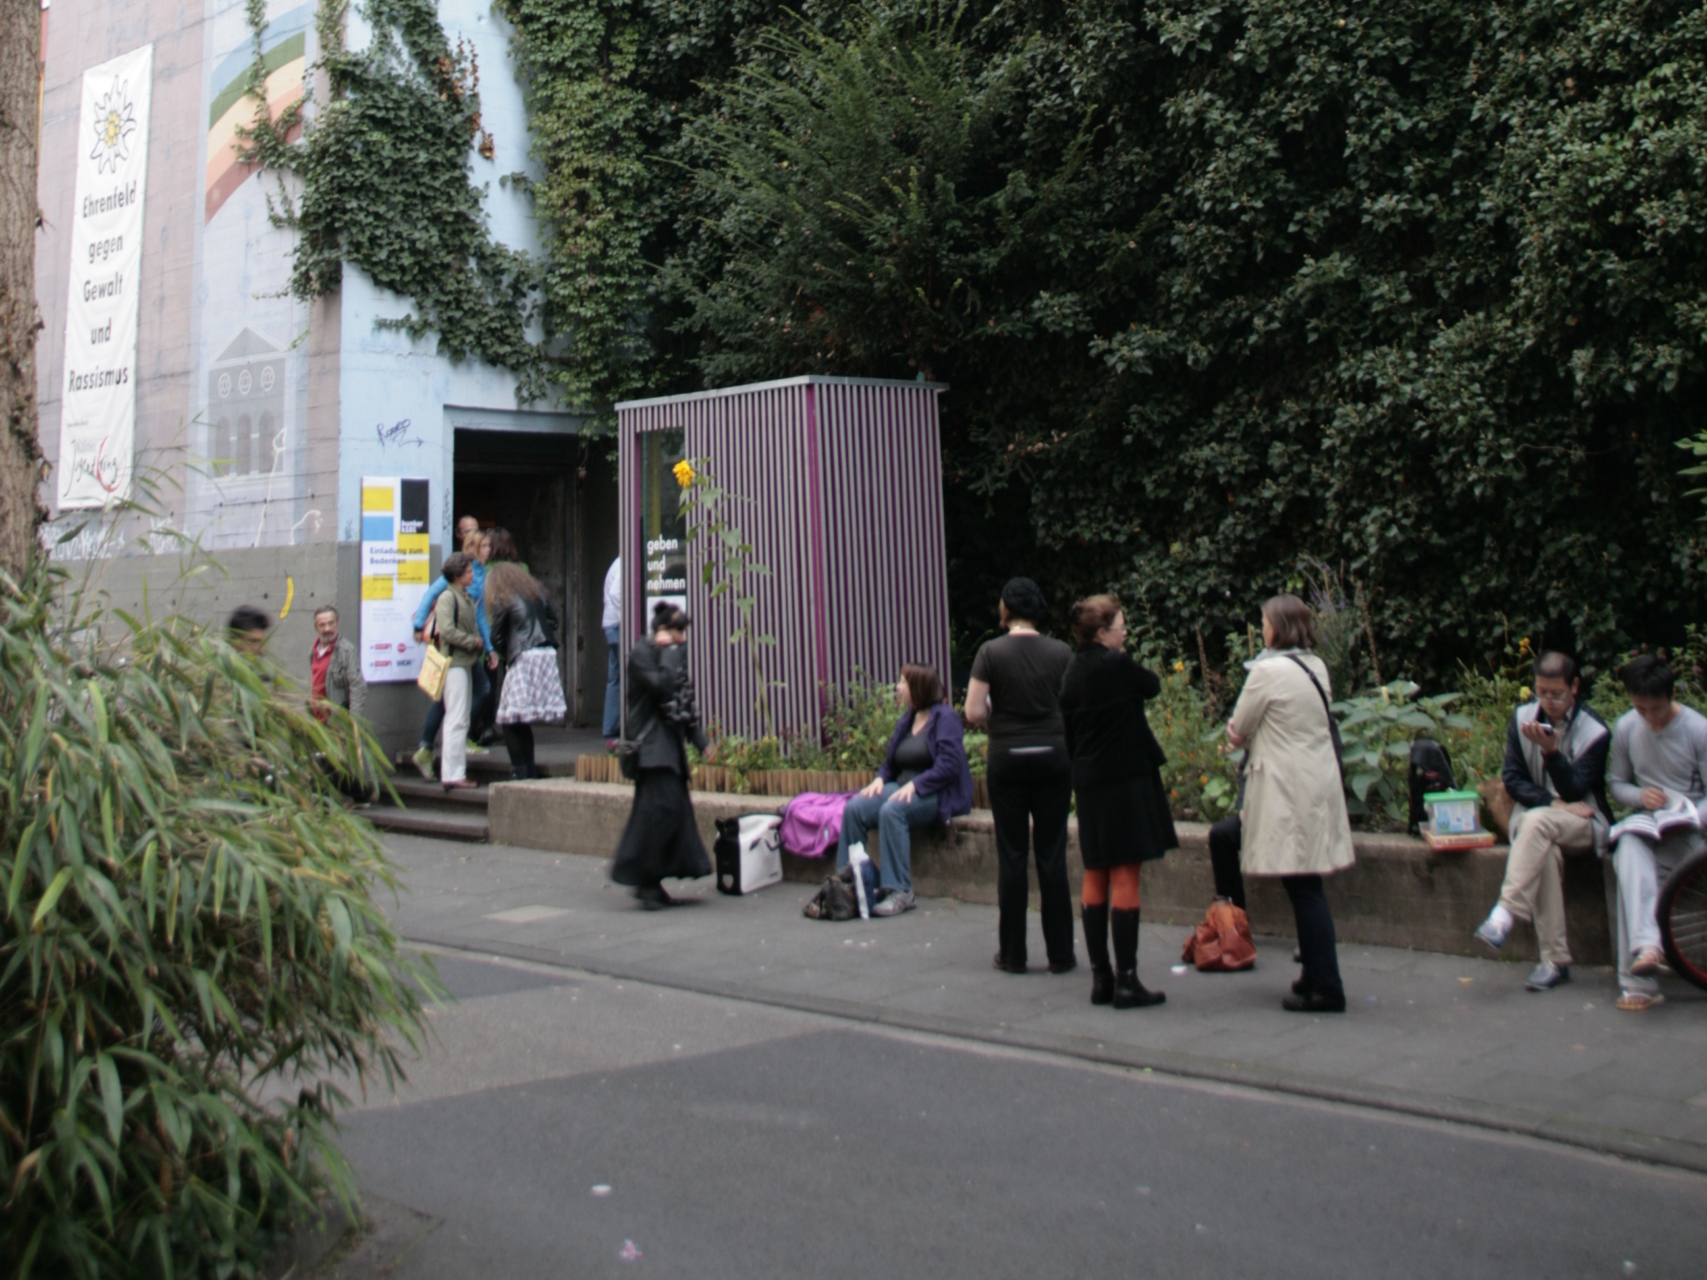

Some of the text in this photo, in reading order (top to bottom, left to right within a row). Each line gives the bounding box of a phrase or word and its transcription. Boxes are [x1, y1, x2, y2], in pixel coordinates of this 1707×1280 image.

[82, 180, 137, 219] Ehrenfeld
[88, 235, 123, 264] gegen
[83, 272, 123, 302] Gewalt
[91, 317, 112, 345] und
[69, 365, 128, 392] Rassismus
[370, 546, 407, 555] Einladung
[647, 534, 678, 556] geben
[370, 556, 407, 564] Bedenken
[647, 553, 666, 571] und
[647, 574, 686, 590] nehmen
